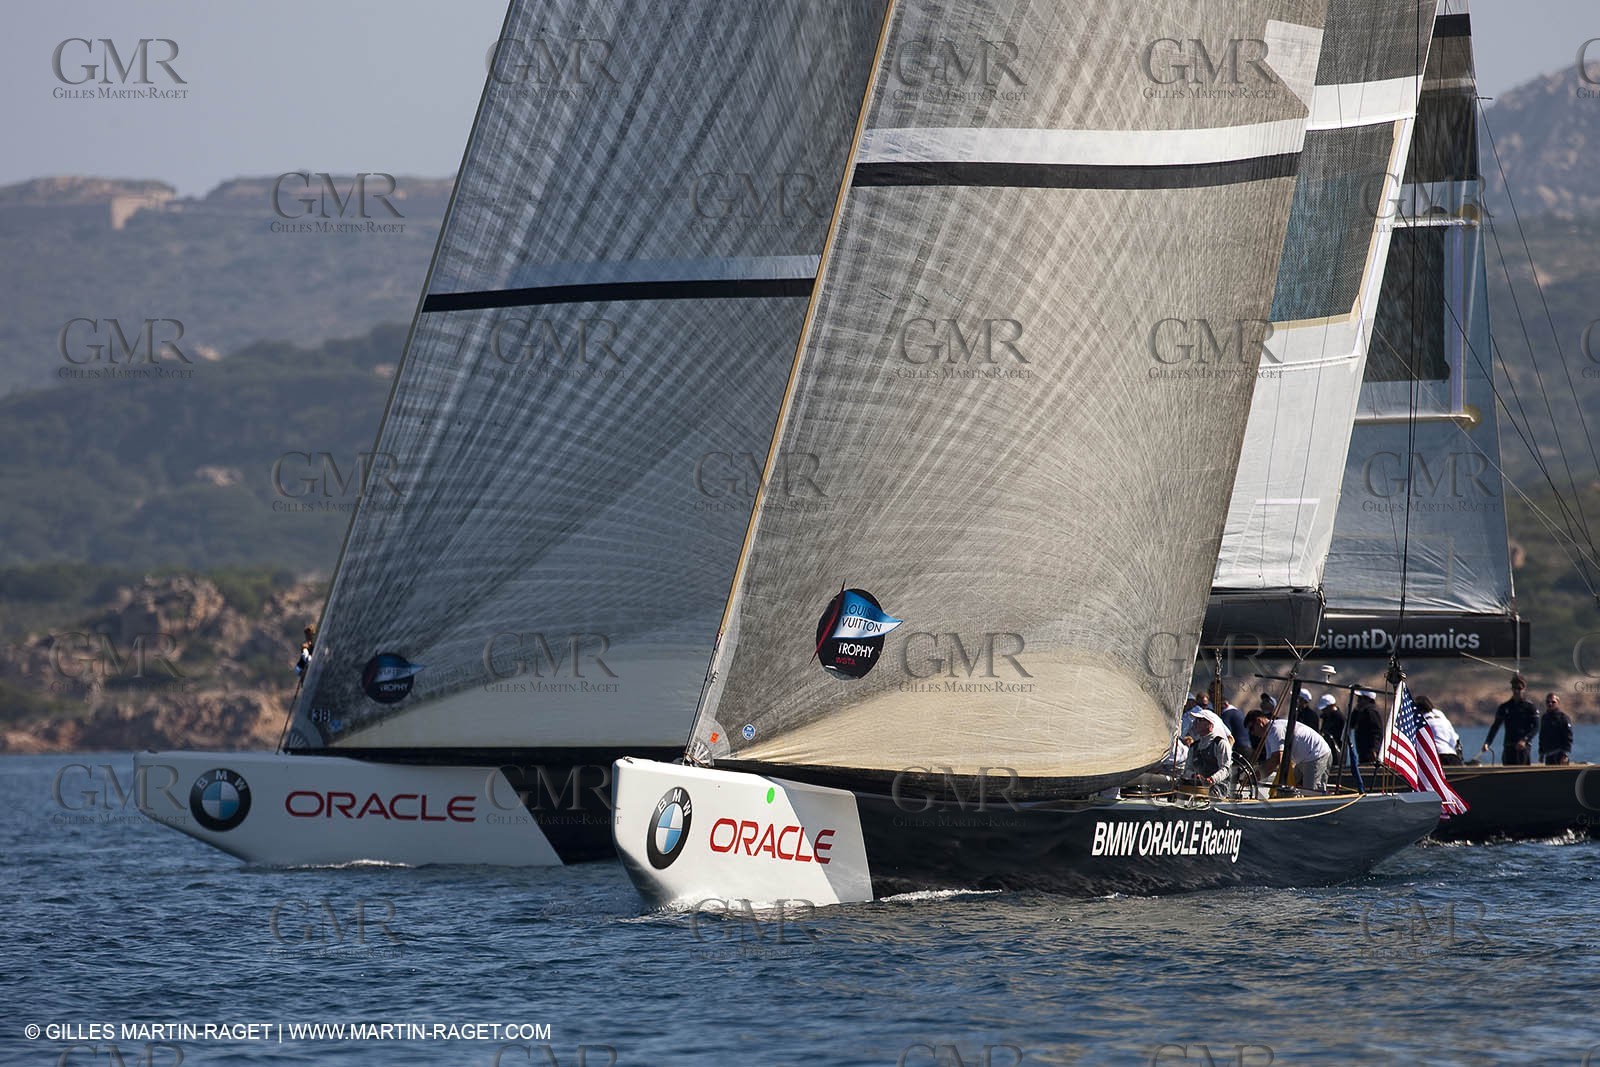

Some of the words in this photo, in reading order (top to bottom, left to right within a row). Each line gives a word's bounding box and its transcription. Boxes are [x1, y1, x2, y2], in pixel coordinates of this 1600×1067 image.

[845, 604, 872, 617] LOUIS
[841, 616, 882, 632] VUITTON
[838, 642, 874, 658] TROPHY
[196, 770, 247, 791] BMW
[285, 791, 477, 822] ORACLE
[658, 788, 692, 817] BMW
[709, 818, 836, 864] ORACLE
[1091, 821, 1139, 856] BMW
[1138, 820, 1202, 856] ORACLE
[1200, 820, 1242, 863] Racing
